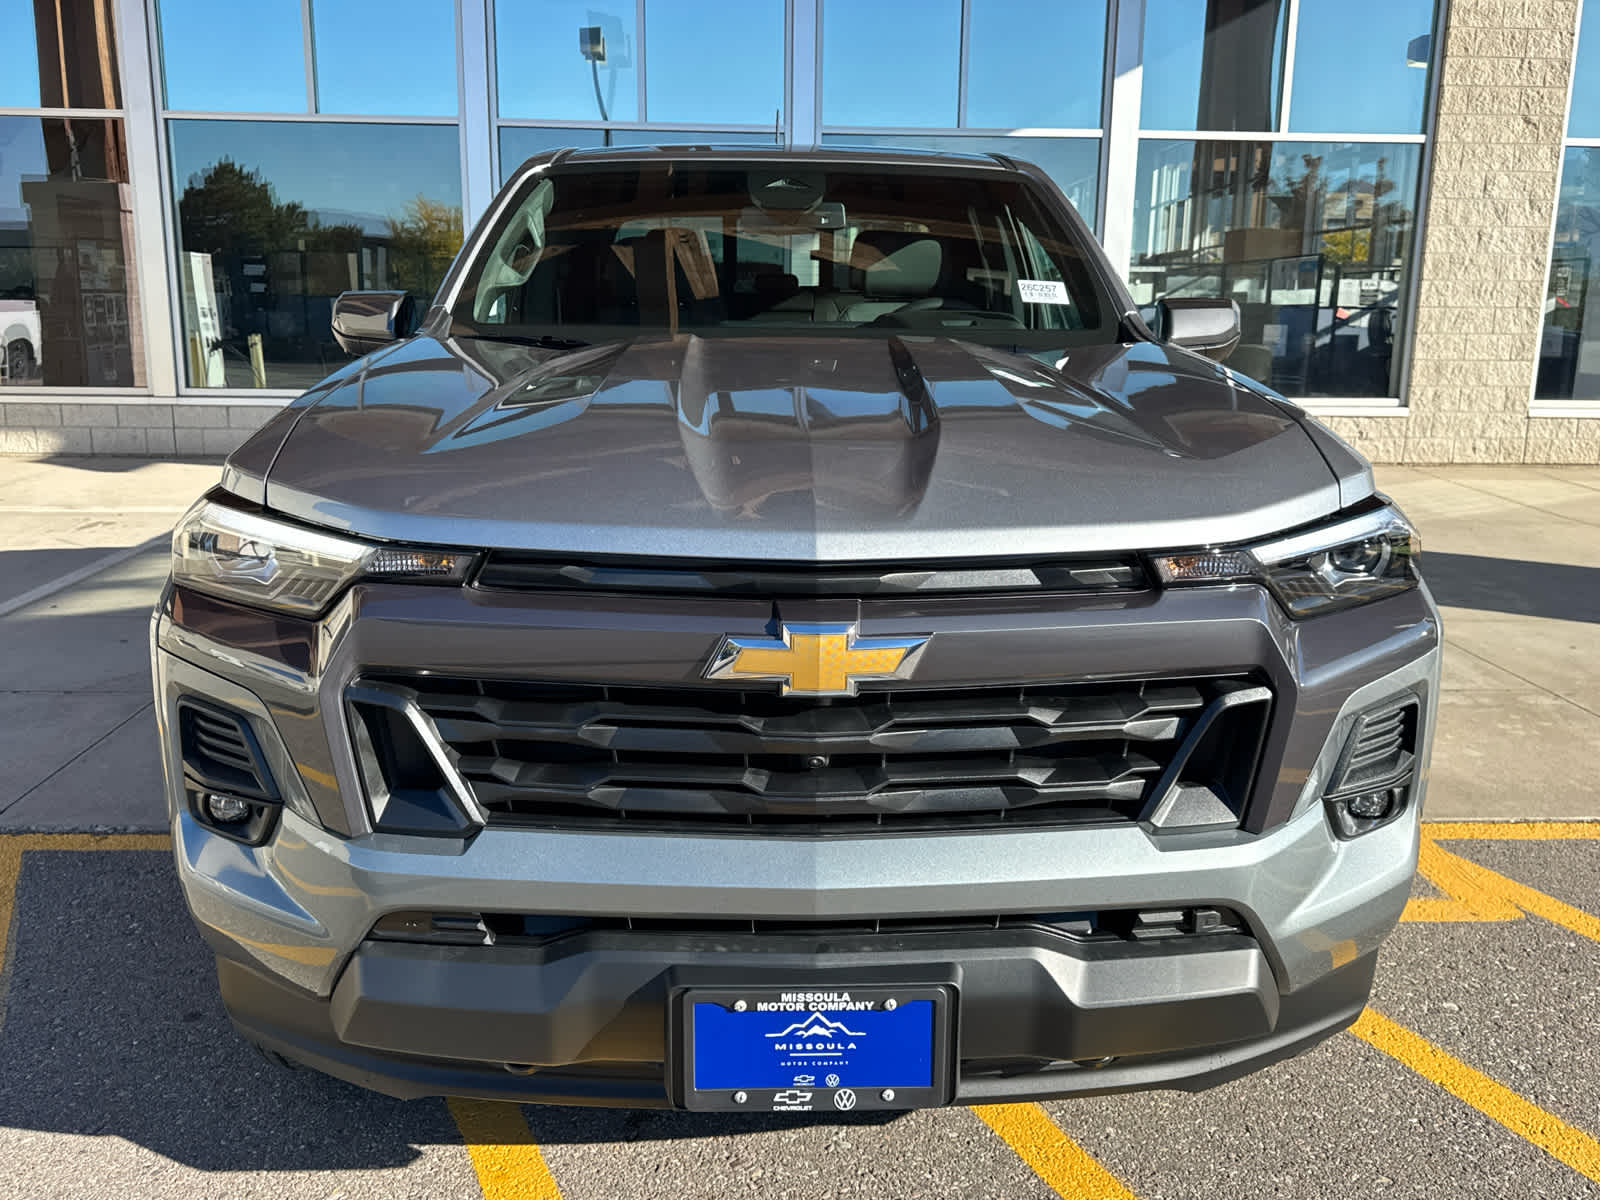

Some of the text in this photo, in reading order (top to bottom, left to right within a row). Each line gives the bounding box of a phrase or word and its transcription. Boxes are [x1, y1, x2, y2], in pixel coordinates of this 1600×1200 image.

[781, 992, 851, 1003] MISSOULA
[757, 1001, 875, 1012] MOTOR COMPANY
[775, 1043, 857, 1051] MISSOULA
